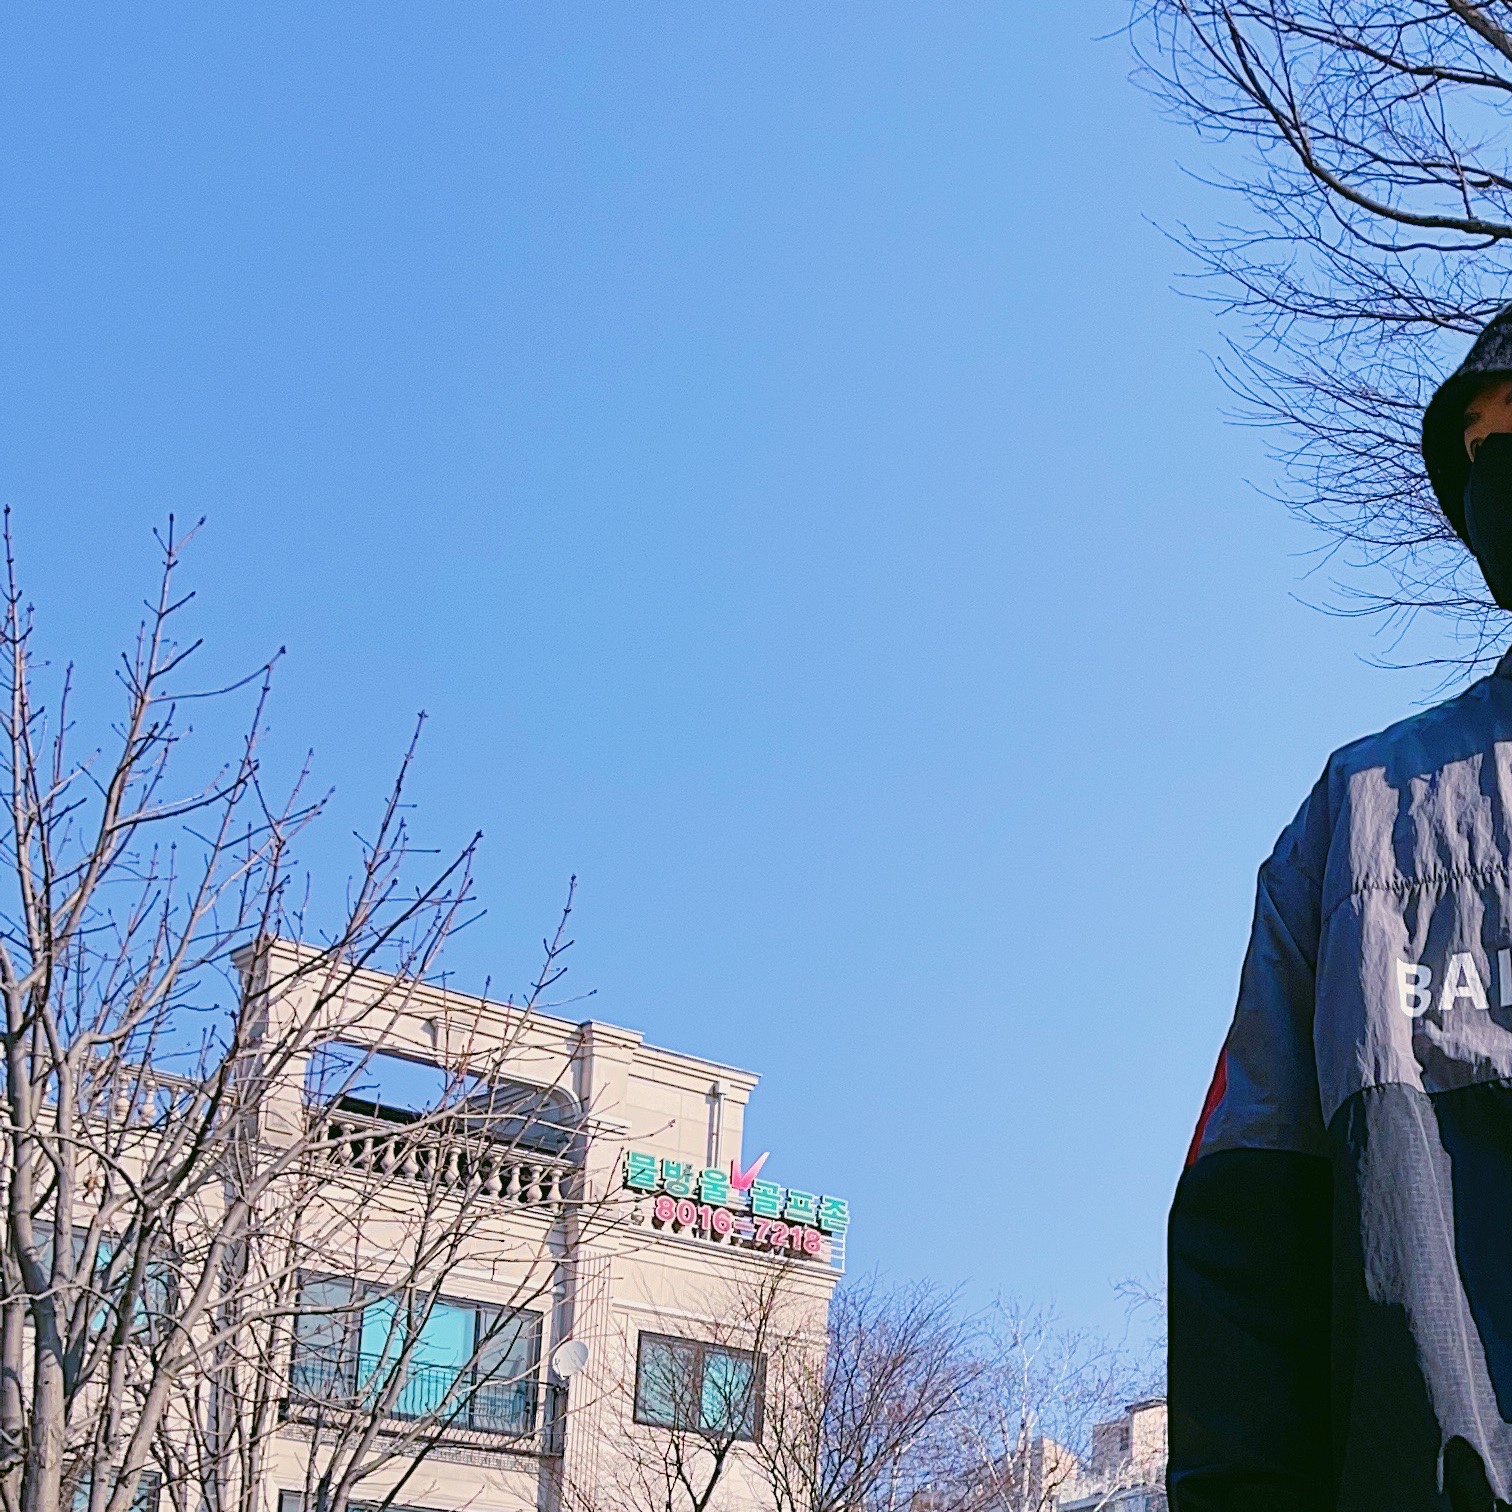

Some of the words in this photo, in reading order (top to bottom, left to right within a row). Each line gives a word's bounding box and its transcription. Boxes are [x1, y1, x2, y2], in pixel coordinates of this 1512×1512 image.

[626, 1150, 730, 1206] 물방울
[750, 1178, 851, 1233] 골프존
[654, 1195, 823, 1255] 8016-7218
